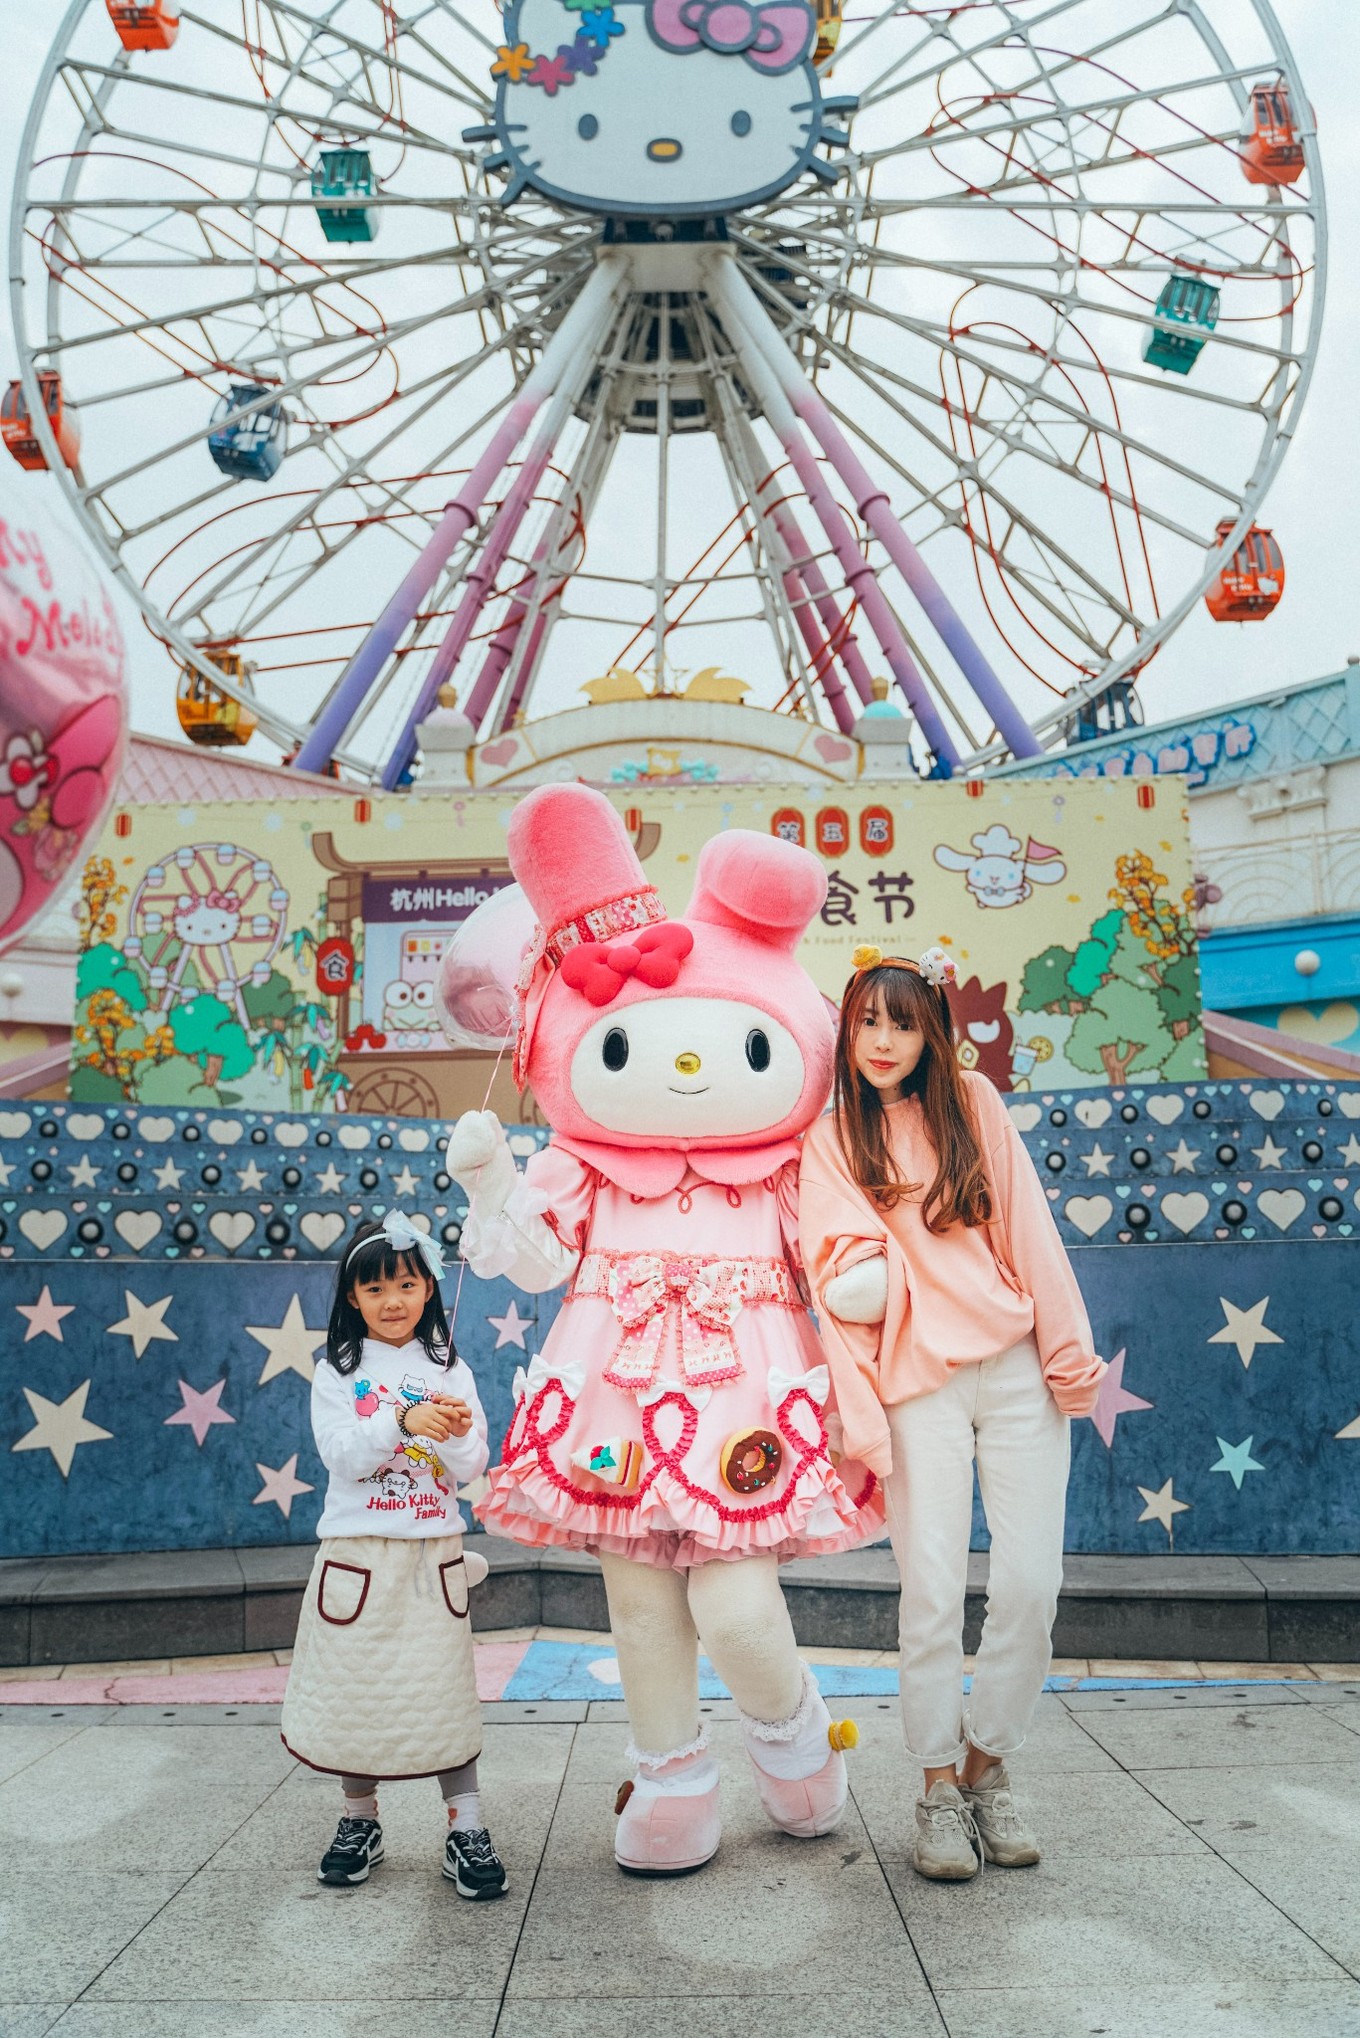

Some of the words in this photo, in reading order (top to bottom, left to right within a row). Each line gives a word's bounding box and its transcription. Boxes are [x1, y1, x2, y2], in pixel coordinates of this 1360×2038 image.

[320, 951, 350, 981] 食
[366, 1496, 407, 1511] Hello
[408, 1492, 441, 1508] Kitty
[414, 1505, 447, 1520] Family
